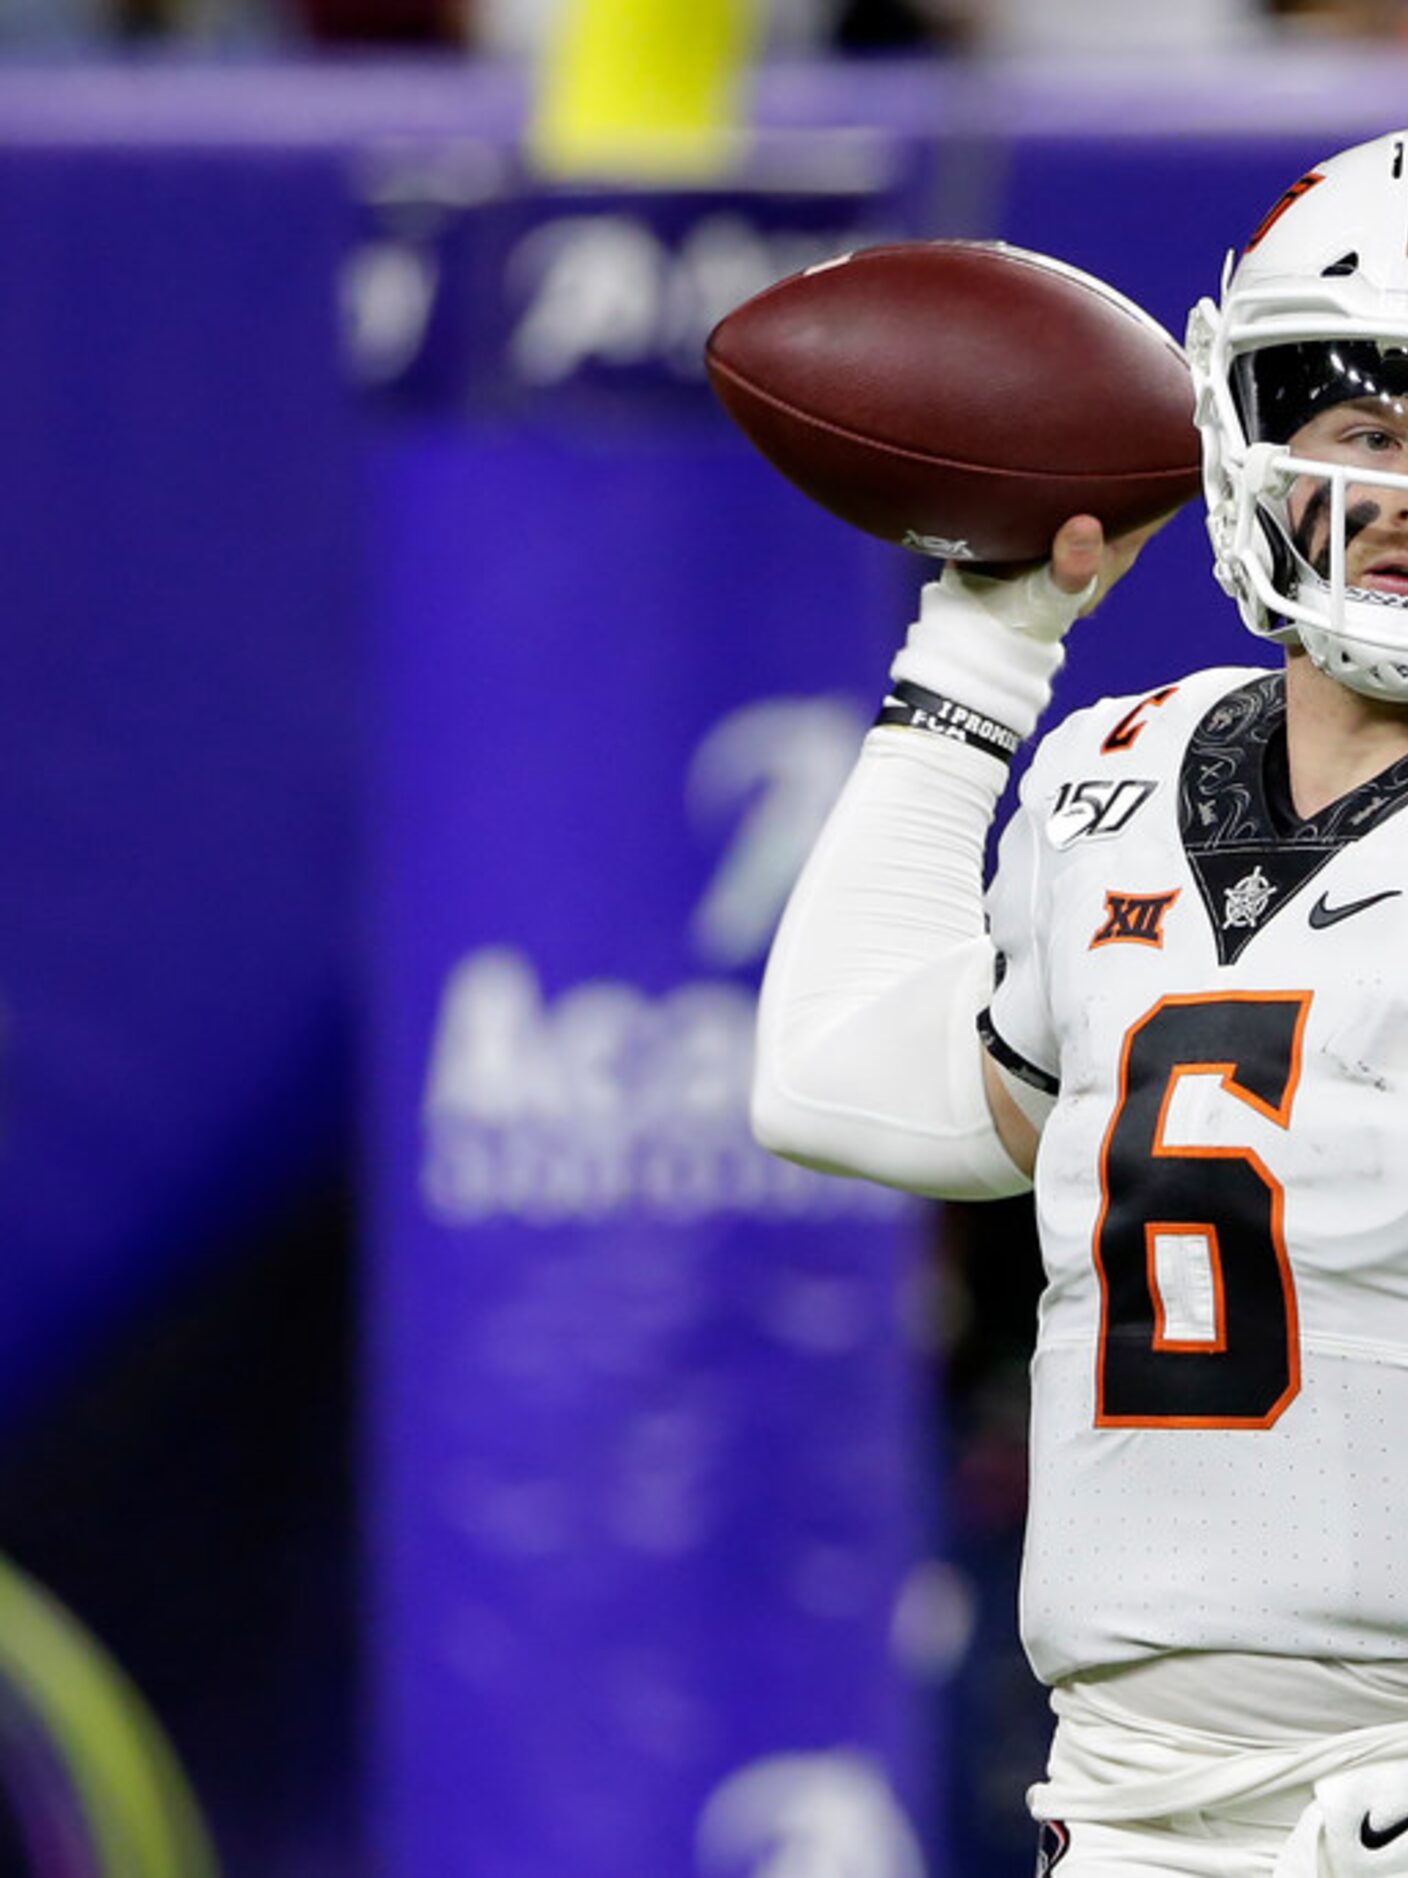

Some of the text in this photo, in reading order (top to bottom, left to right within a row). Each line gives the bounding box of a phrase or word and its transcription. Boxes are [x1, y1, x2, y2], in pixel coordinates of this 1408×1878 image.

[937, 701, 952, 719] I
[1051, 780, 1159, 846] 150
[1090, 889, 1180, 948] XII
[1093, 990, 1314, 1430] 6
